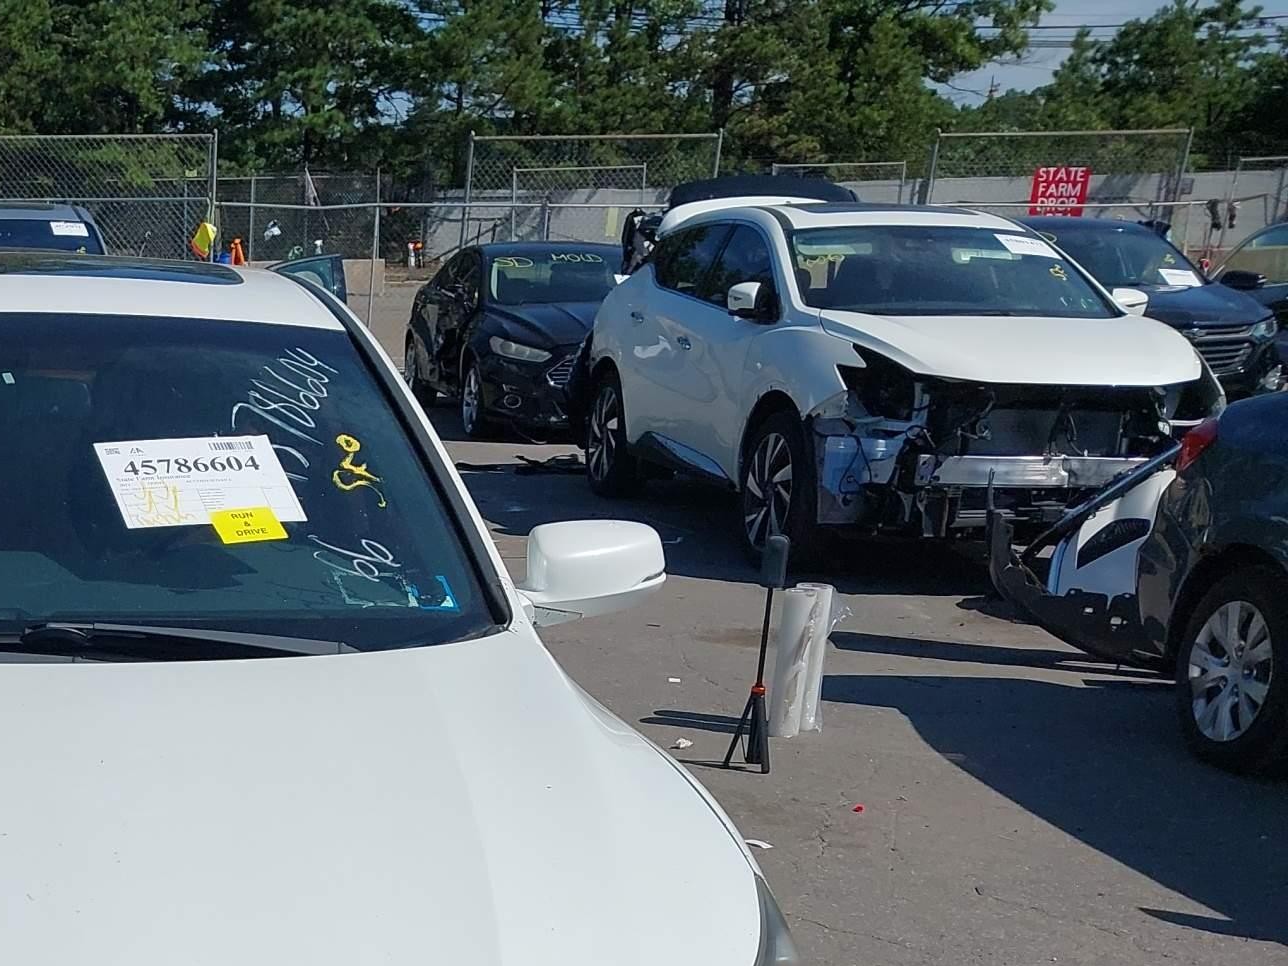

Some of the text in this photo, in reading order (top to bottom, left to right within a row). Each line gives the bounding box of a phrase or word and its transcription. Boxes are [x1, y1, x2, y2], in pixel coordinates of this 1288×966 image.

[1038, 167, 1087, 181] STATE
[1037, 182, 1082, 197] FARM
[231, 347, 339, 481] 786604
[123, 455, 261, 476] 45786604
[235, 527, 269, 537] DRIVE
